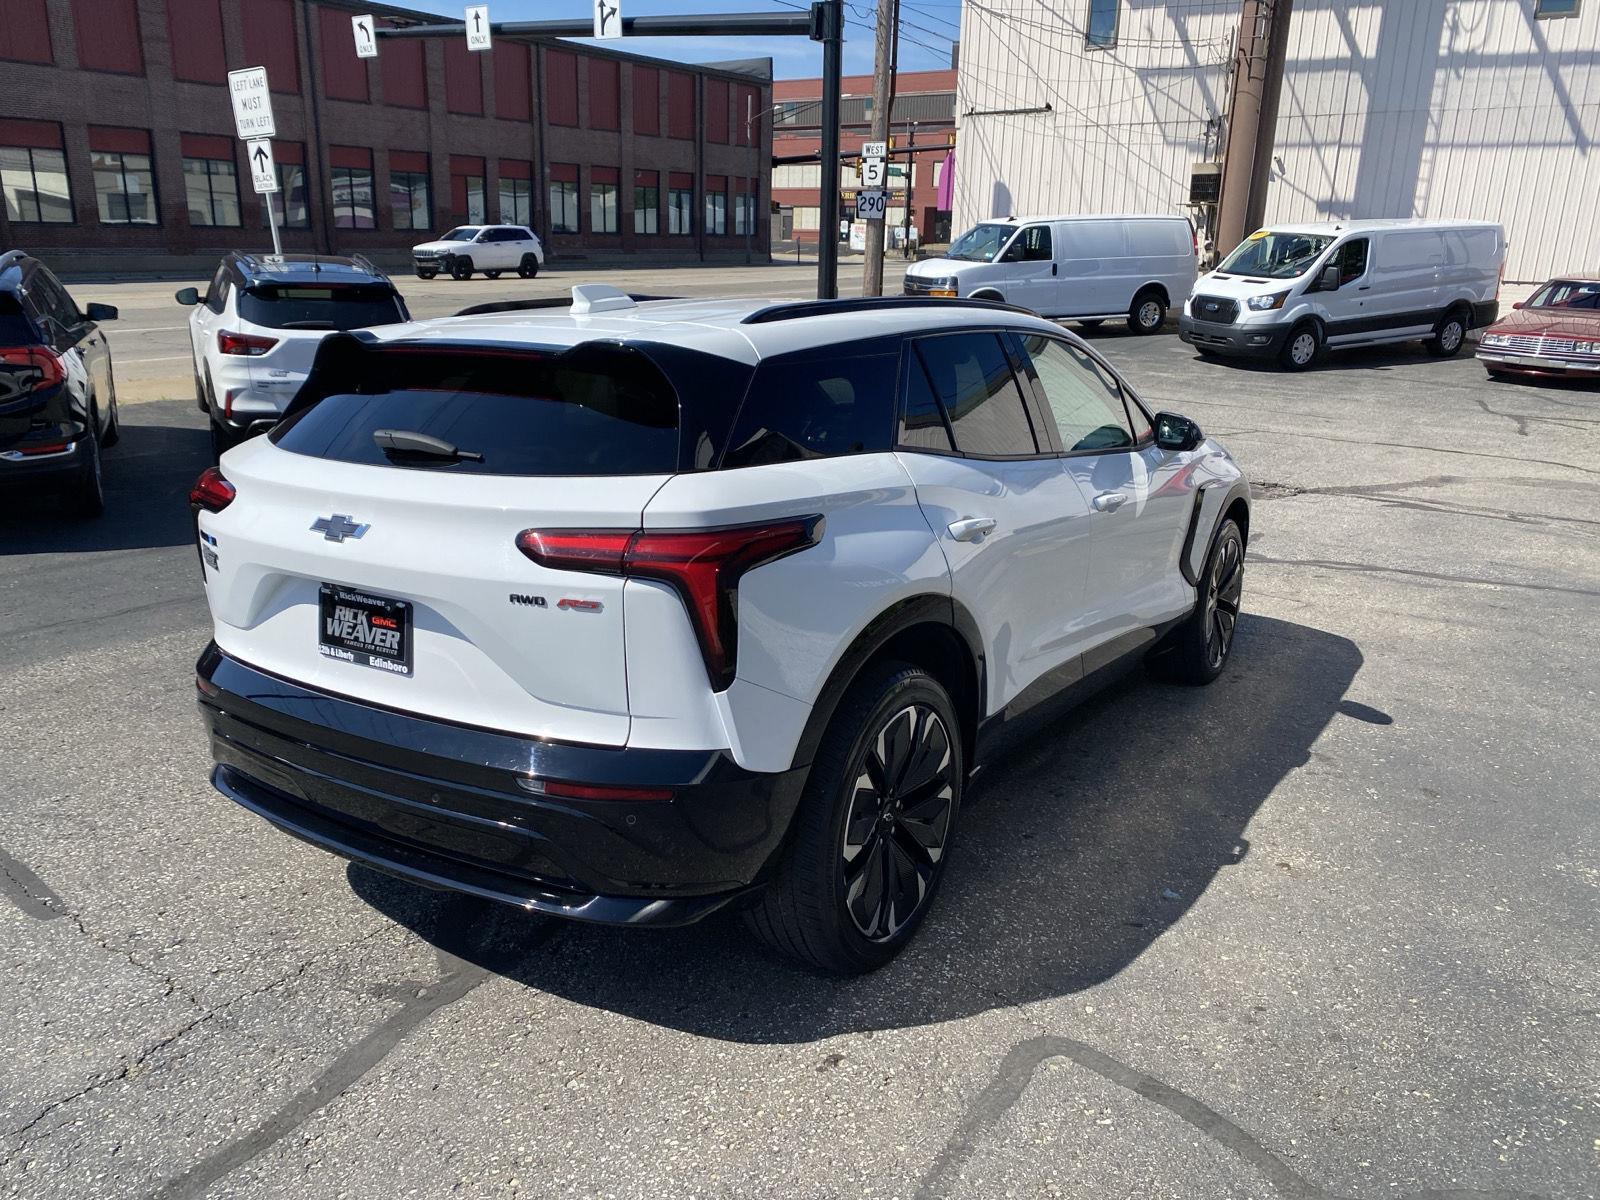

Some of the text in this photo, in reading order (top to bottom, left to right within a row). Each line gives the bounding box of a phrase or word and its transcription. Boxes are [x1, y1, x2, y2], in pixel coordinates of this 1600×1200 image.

[470, 35, 487, 45] ONLY
[359, 45, 373, 54] ONLY
[232, 76, 264, 92] LEFT LANE
[241, 96, 262, 111] MUST
[239, 115, 271, 130] TURN LEFT
[865, 145, 884, 155] WEST
[255, 173, 273, 183] BLACK
[868, 165, 878, 180] 5
[860, 196, 884, 212] 290
[339, 591, 386, 607] RickWeaver
[509, 593, 546, 606] AWD
[334, 605, 369, 626] RICK
[372, 615, 397, 628] GMC
[326, 617, 400, 650] WEAVER
[335, 648, 355, 662] Liberty
[369, 656, 408, 674] Edinboro
